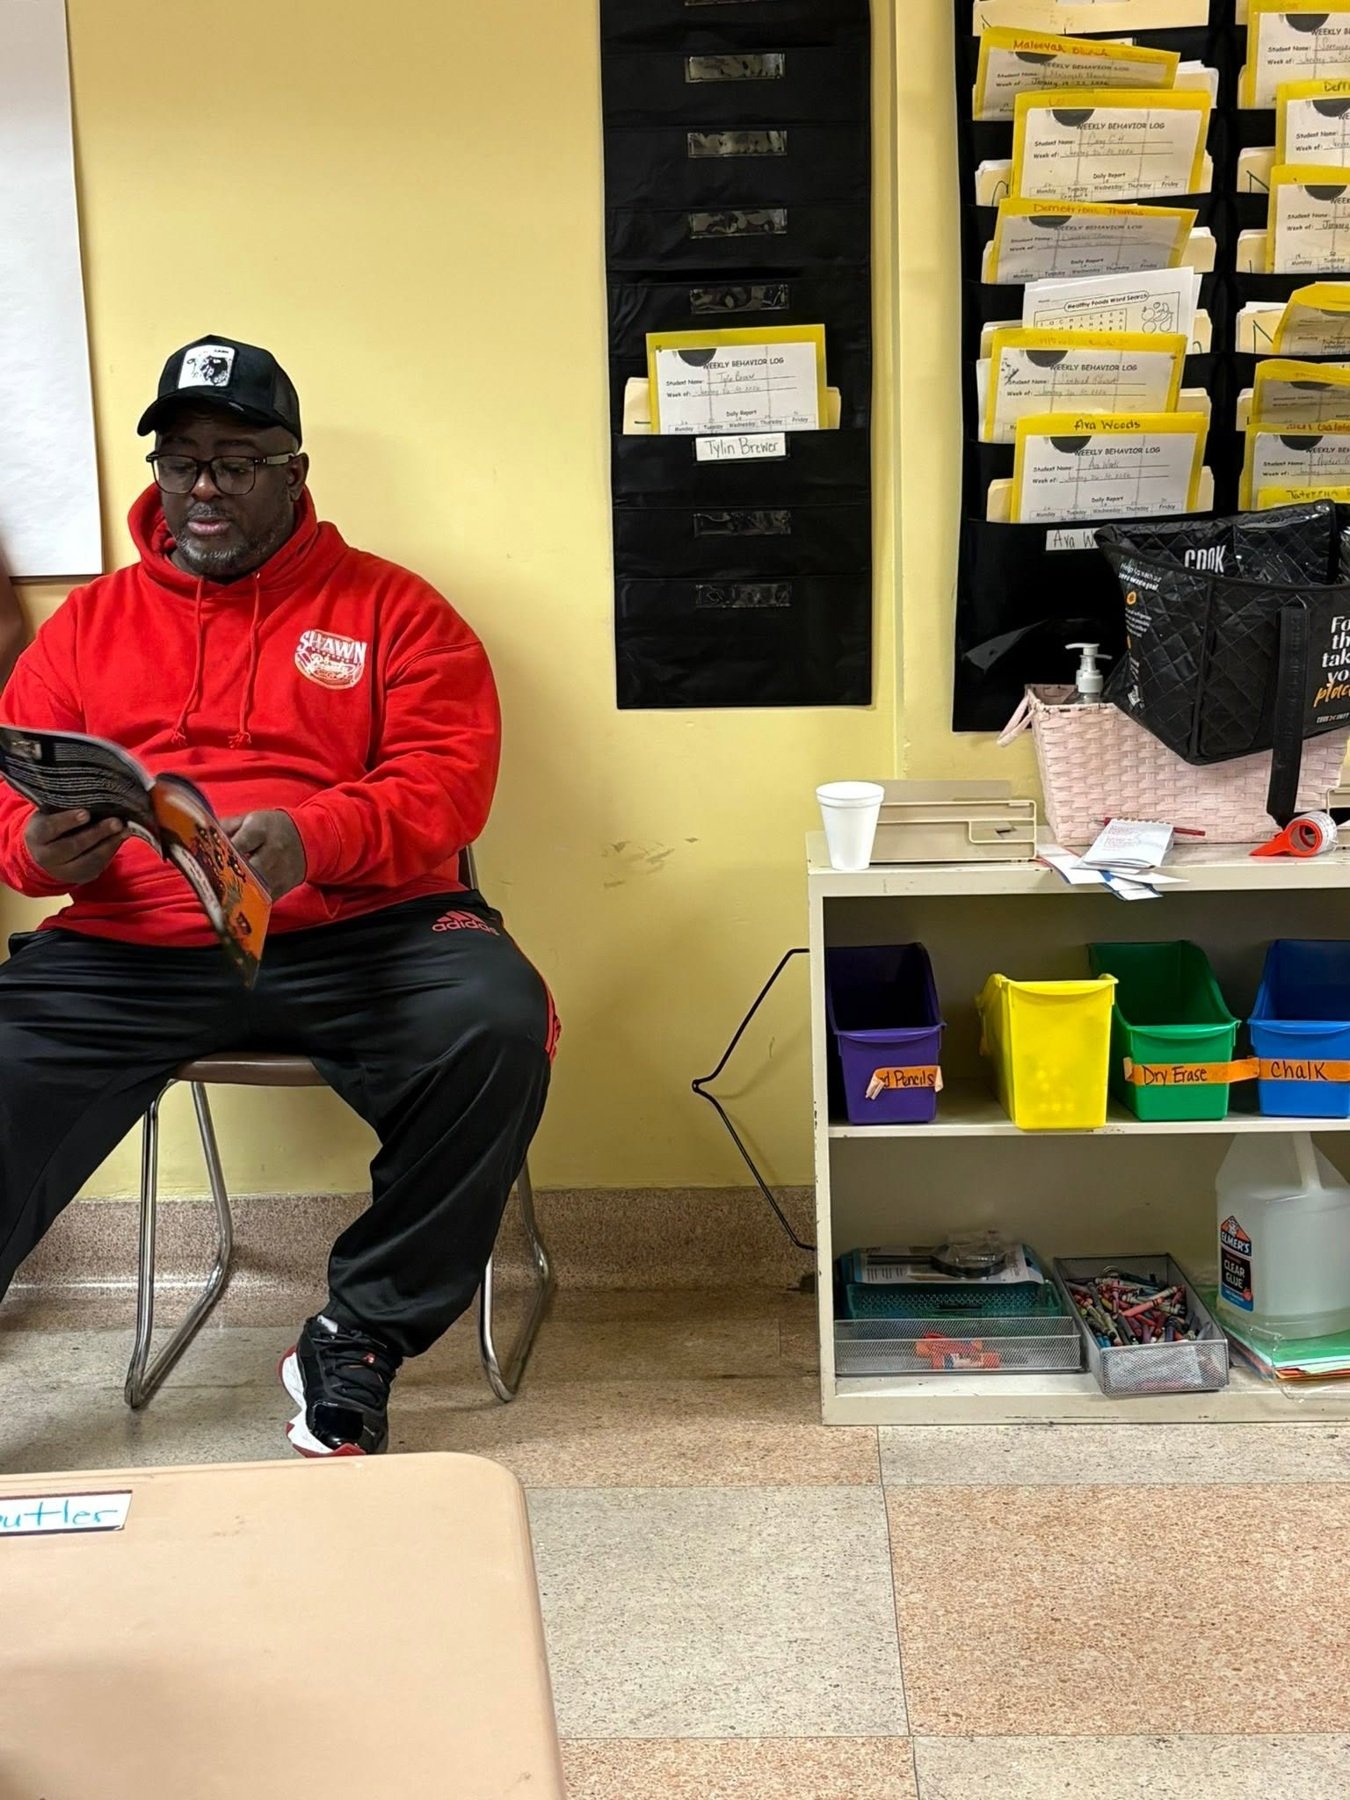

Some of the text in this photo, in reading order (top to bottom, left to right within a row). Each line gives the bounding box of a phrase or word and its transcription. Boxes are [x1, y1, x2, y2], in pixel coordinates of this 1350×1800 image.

[1311, 28, 1341, 36] WEEKLY
[1108, 122, 1148, 130] BEHAVIOR
[1127, 293, 1148, 301] Search
[703, 360, 730, 370] WEEKLY
[732, 357, 768, 367] BEHAVIOR
[726, 411, 739, 419] Daily
[1101, 419, 1141, 430] Woods
[705, 437, 780, 458] Tylin Brewer
[1105, 447, 1143, 455] BEHAVIOR
[1331, 616, 1350, 634] Fo
[297, 630, 367, 664] SHAWN
[1332, 631, 1350, 650] th
[1322, 648, 1350, 668] tak
[1327, 669, 1350, 687] yo
[1313, 684, 1350, 708] plac
[432, 920, 500, 936] adidas
[894, 1070, 935, 1087] Pencils
[1142, 1065, 1208, 1086] Dry Erase
[1221, 1231, 1250, 1253] ELMER'S
[1224, 1260, 1246, 1279] CLEAR
[1225, 1272, 1244, 1289] GLUE
[0, 1499, 118, 1528] utler
